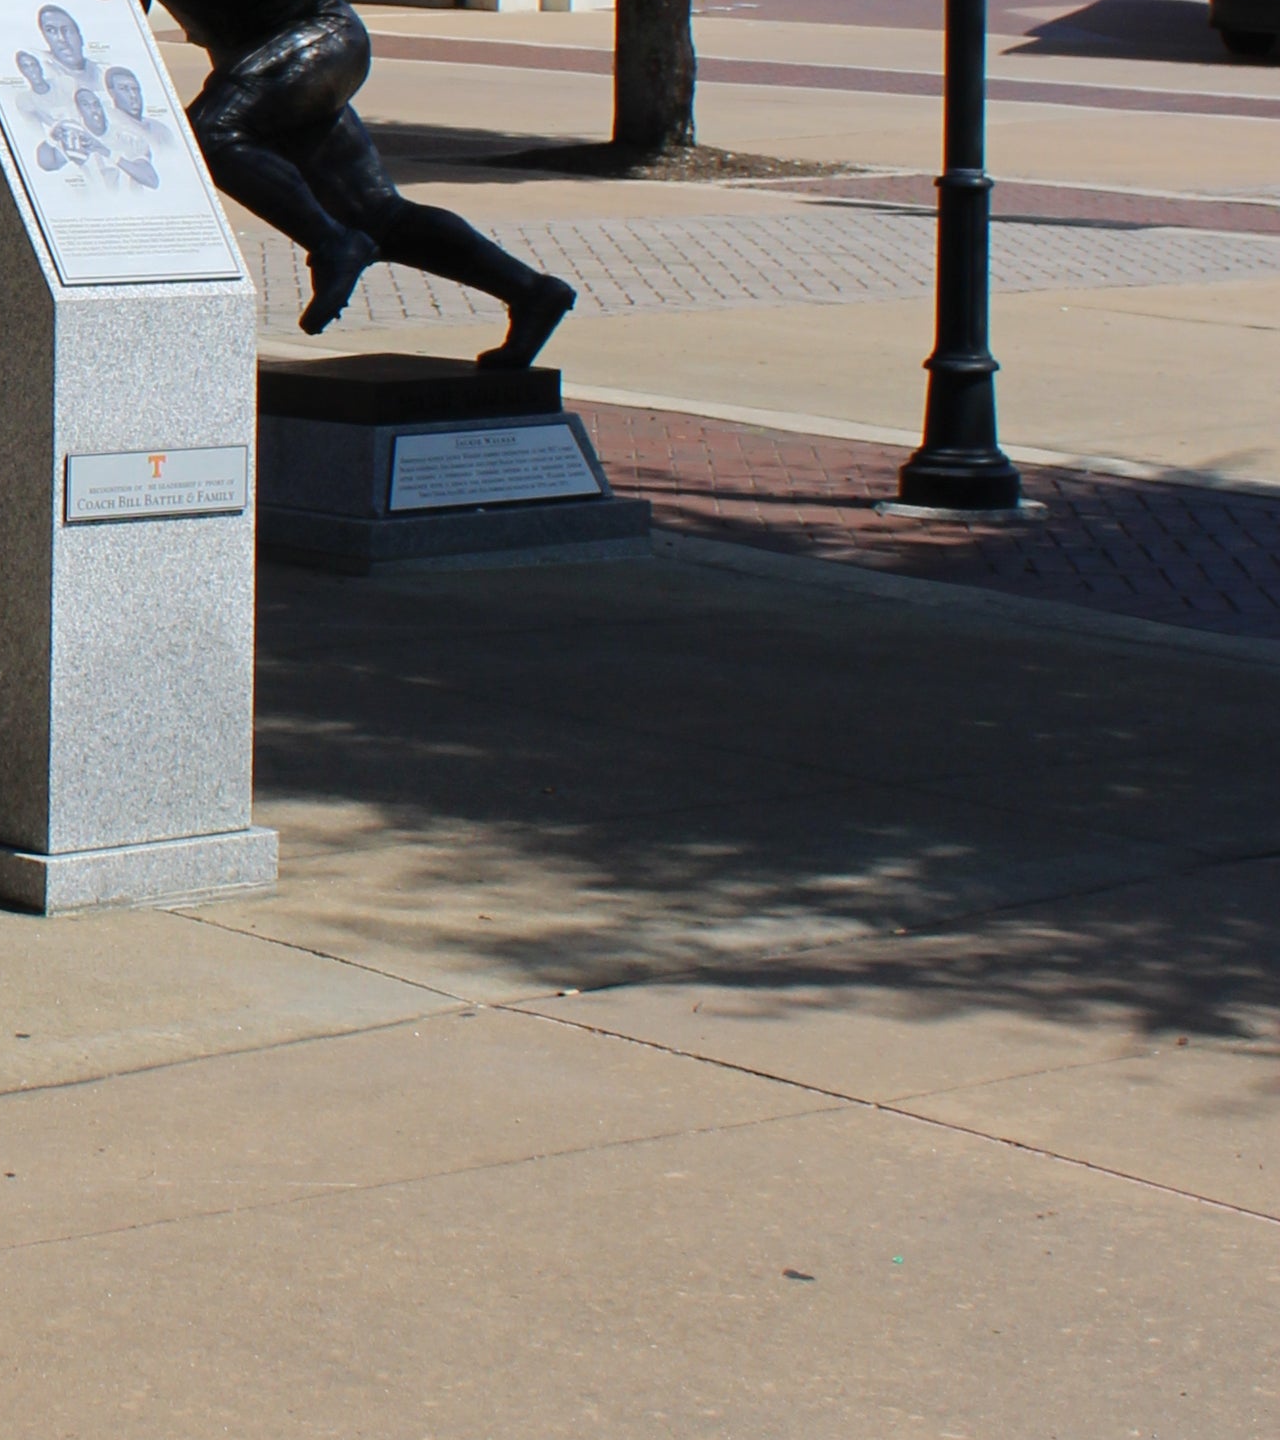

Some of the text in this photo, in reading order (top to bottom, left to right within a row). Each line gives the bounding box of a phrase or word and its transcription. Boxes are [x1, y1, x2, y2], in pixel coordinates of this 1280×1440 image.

[148, 454, 167, 479] T
[77, 496, 115, 512] COACH
[118, 495, 141, 509] BILL
[144, 493, 183, 507] BATTLE
[197, 490, 236, 503] FAMILY
